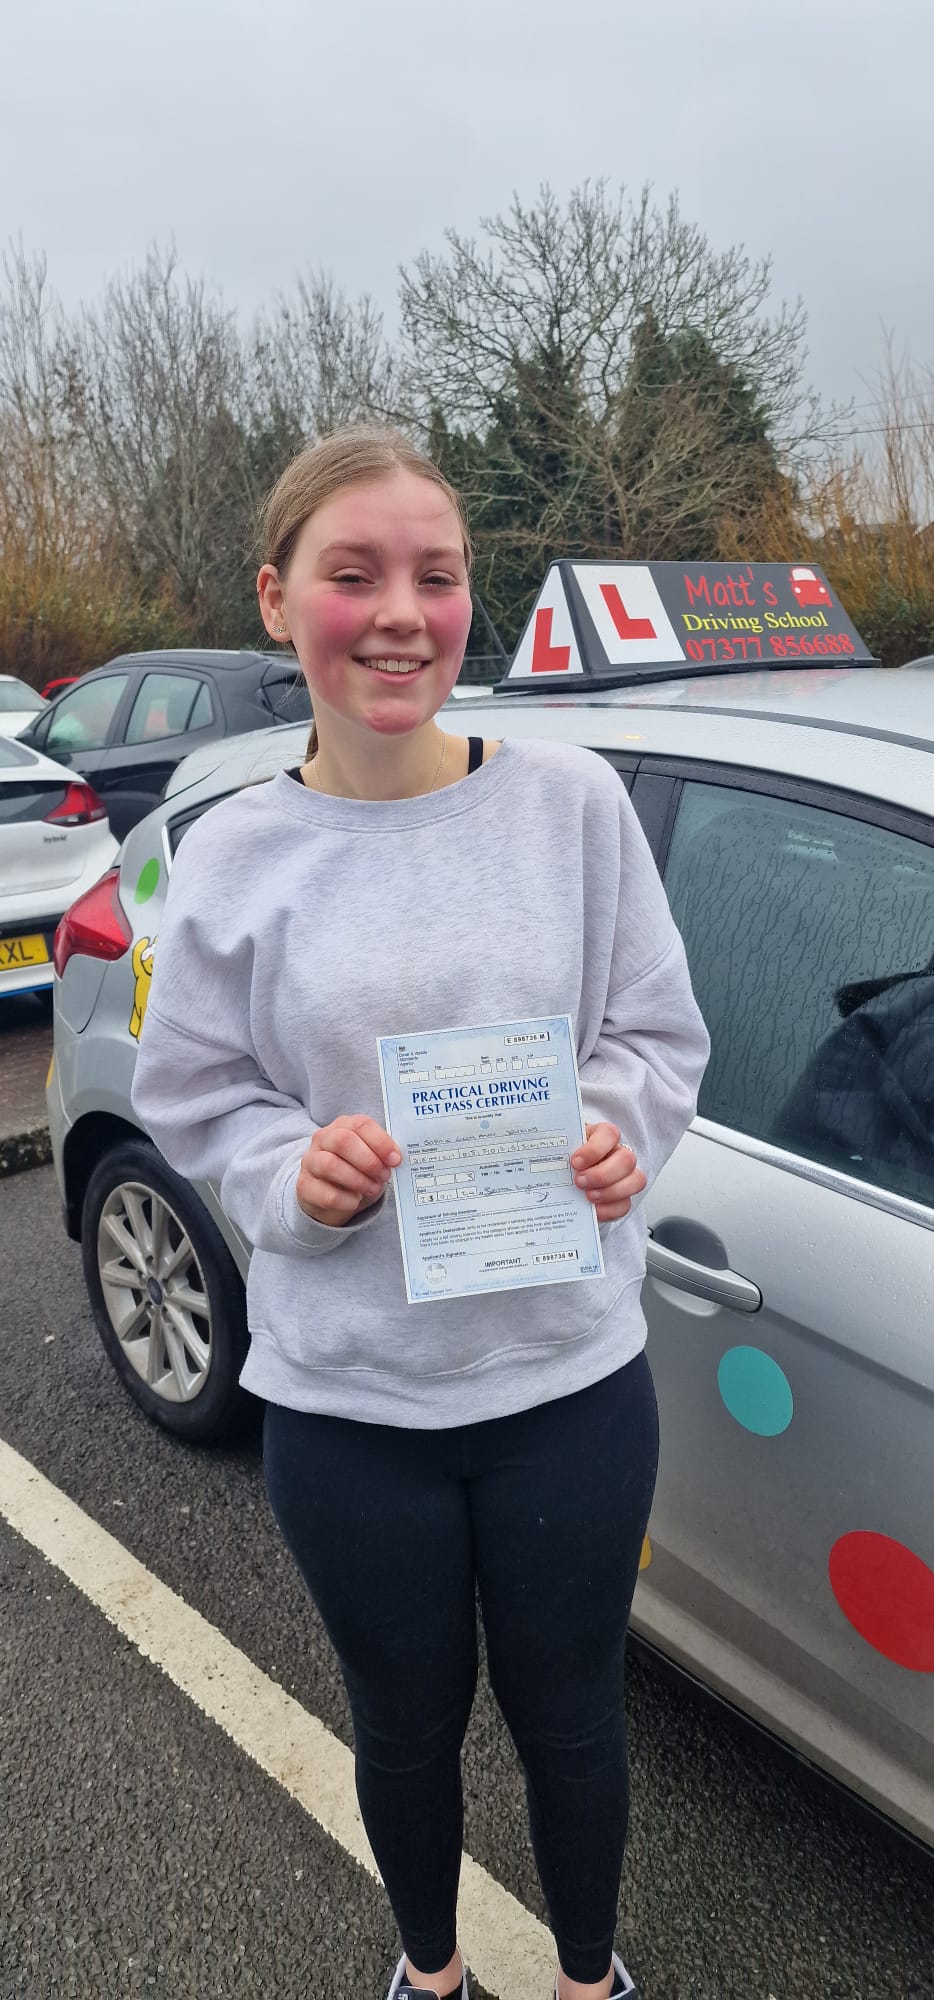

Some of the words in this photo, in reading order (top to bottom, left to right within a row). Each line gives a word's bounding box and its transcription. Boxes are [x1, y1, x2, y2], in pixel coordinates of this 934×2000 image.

[684, 566, 778, 607] Matt's
[599, 584, 658, 640] L
[681, 612, 764, 633] Driving
[764, 611, 829, 629] School
[531, 607, 571, 673] L
[685, 636, 763, 661] 07377
[769, 633, 855, 657] 856688
[0, 941, 34, 964] XL
[412, 1085, 484, 1104] PRACTICAL
[489, 1076, 549, 1095] DRIVING
[413, 1103, 441, 1116] TEST
[445, 1100, 473, 1113] PASS
[476, 1090, 551, 1109] CERTIFICATE
[485, 1257, 521, 1267] IMPORTANT
